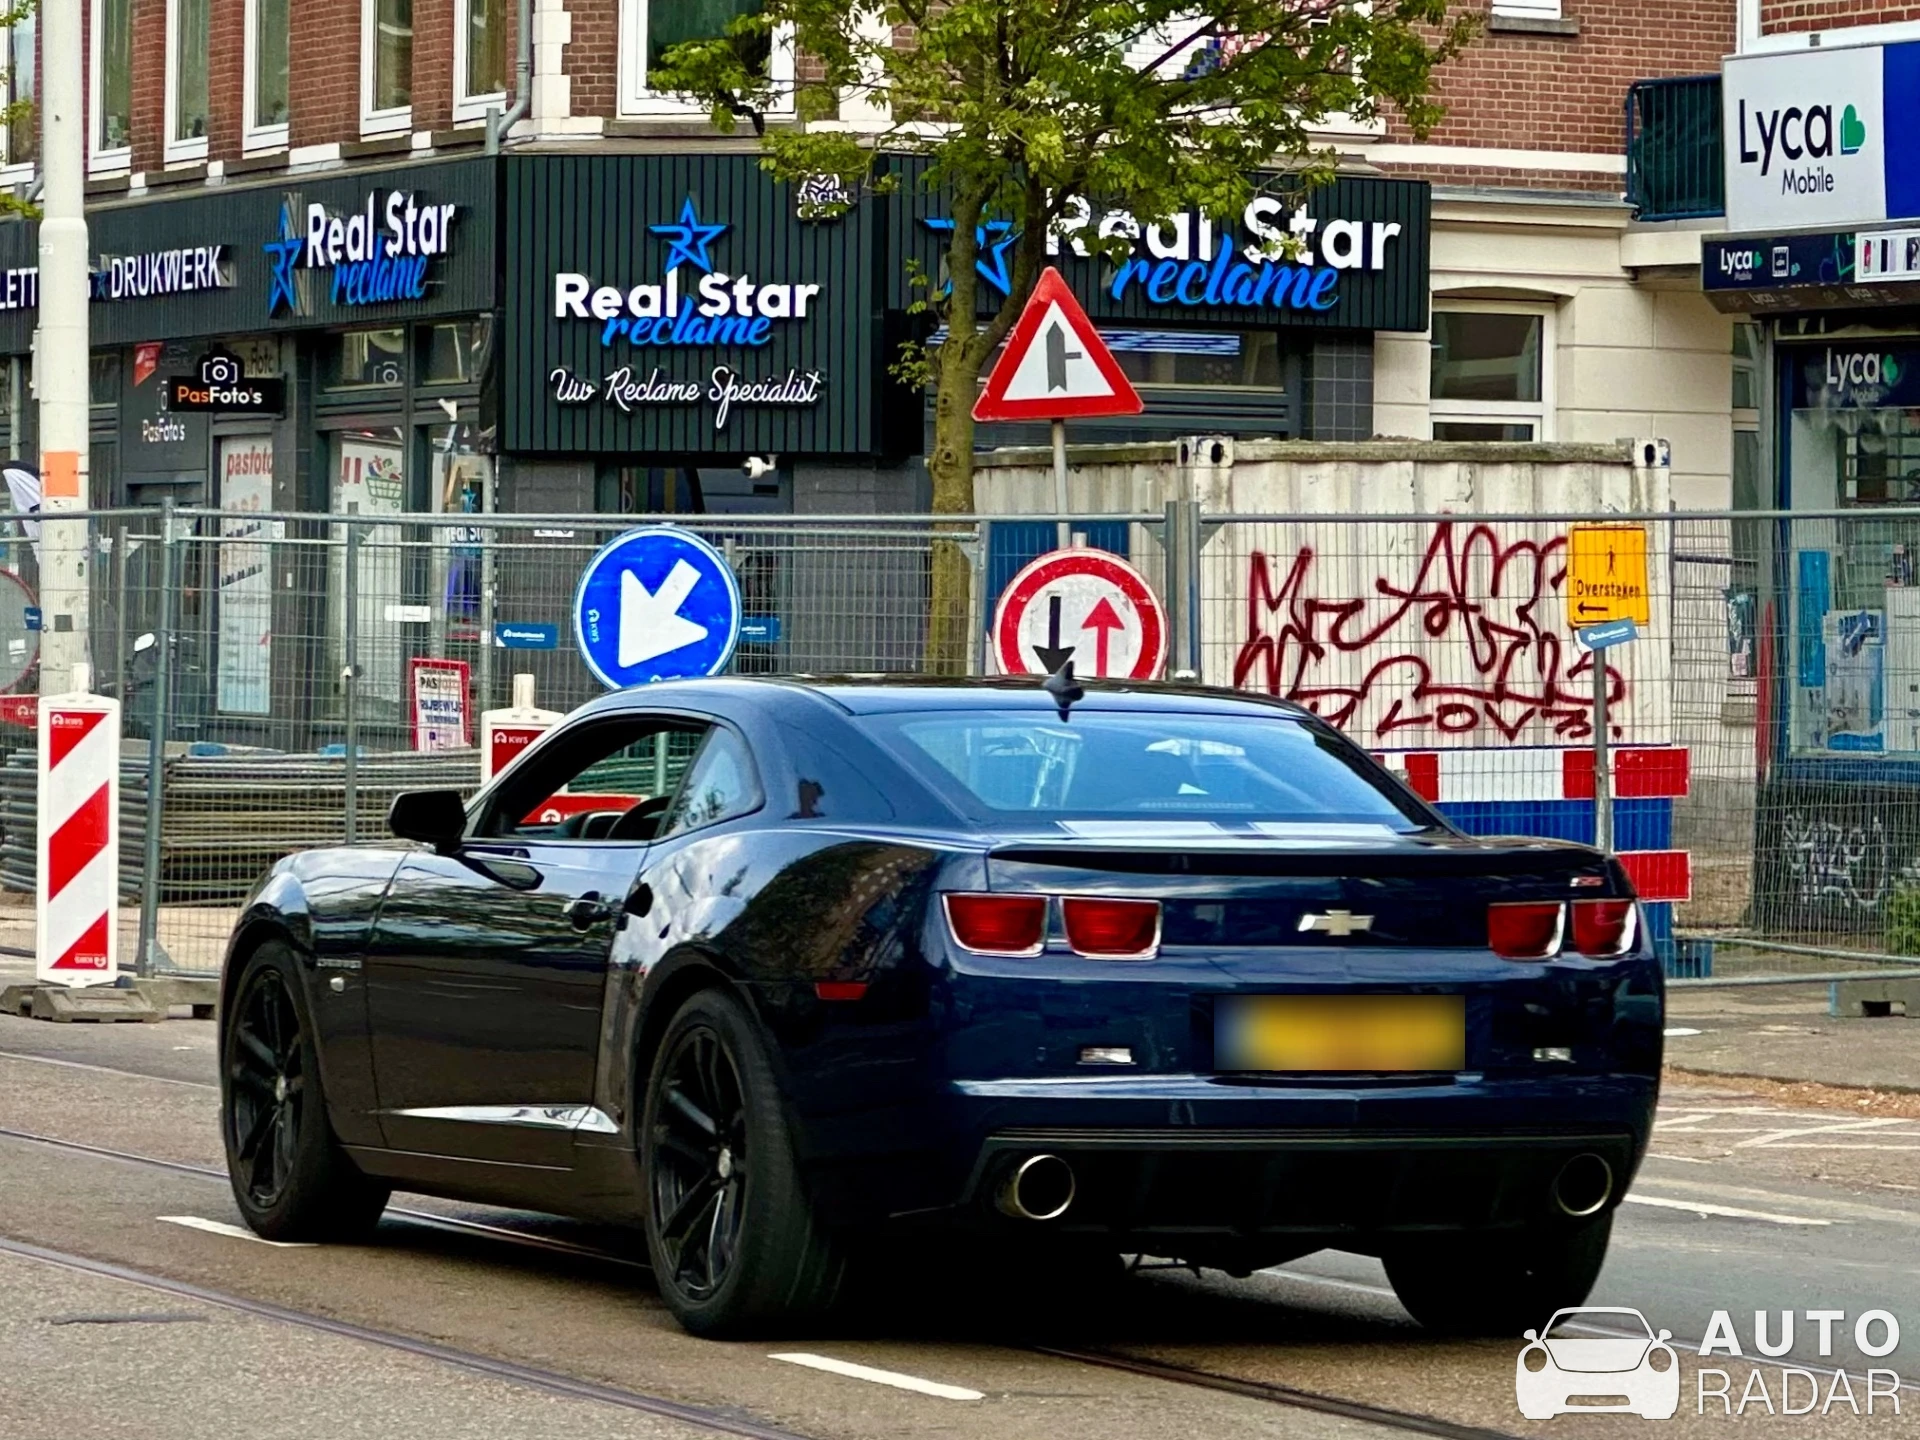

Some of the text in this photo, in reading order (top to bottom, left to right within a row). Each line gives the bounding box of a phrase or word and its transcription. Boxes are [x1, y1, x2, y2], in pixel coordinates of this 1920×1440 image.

[1739, 99, 1833, 176] Lyca
[1782, 166, 1835, 196] Mobile
[307, 190, 455, 269] Real Star
[1044, 186, 1402, 271] Real Star
[111, 245, 222, 299] DRUKWERK
[330, 233, 428, 307] reclame
[1111, 232, 1340, 311] reclame
[1721, 248, 1753, 275] Lyca
[555, 266, 820, 321] Real Star
[602, 295, 772, 347] reclame
[177, 385, 263, 405] PasFoto's
[1827, 347, 1880, 392] Lyca
[550, 365, 820, 429] Uw Reclame Specialist
[142, 418, 186, 443] PasFoto's
[1576, 579, 1641, 598] Oversteken
[508, 736, 529, 745] KWS
